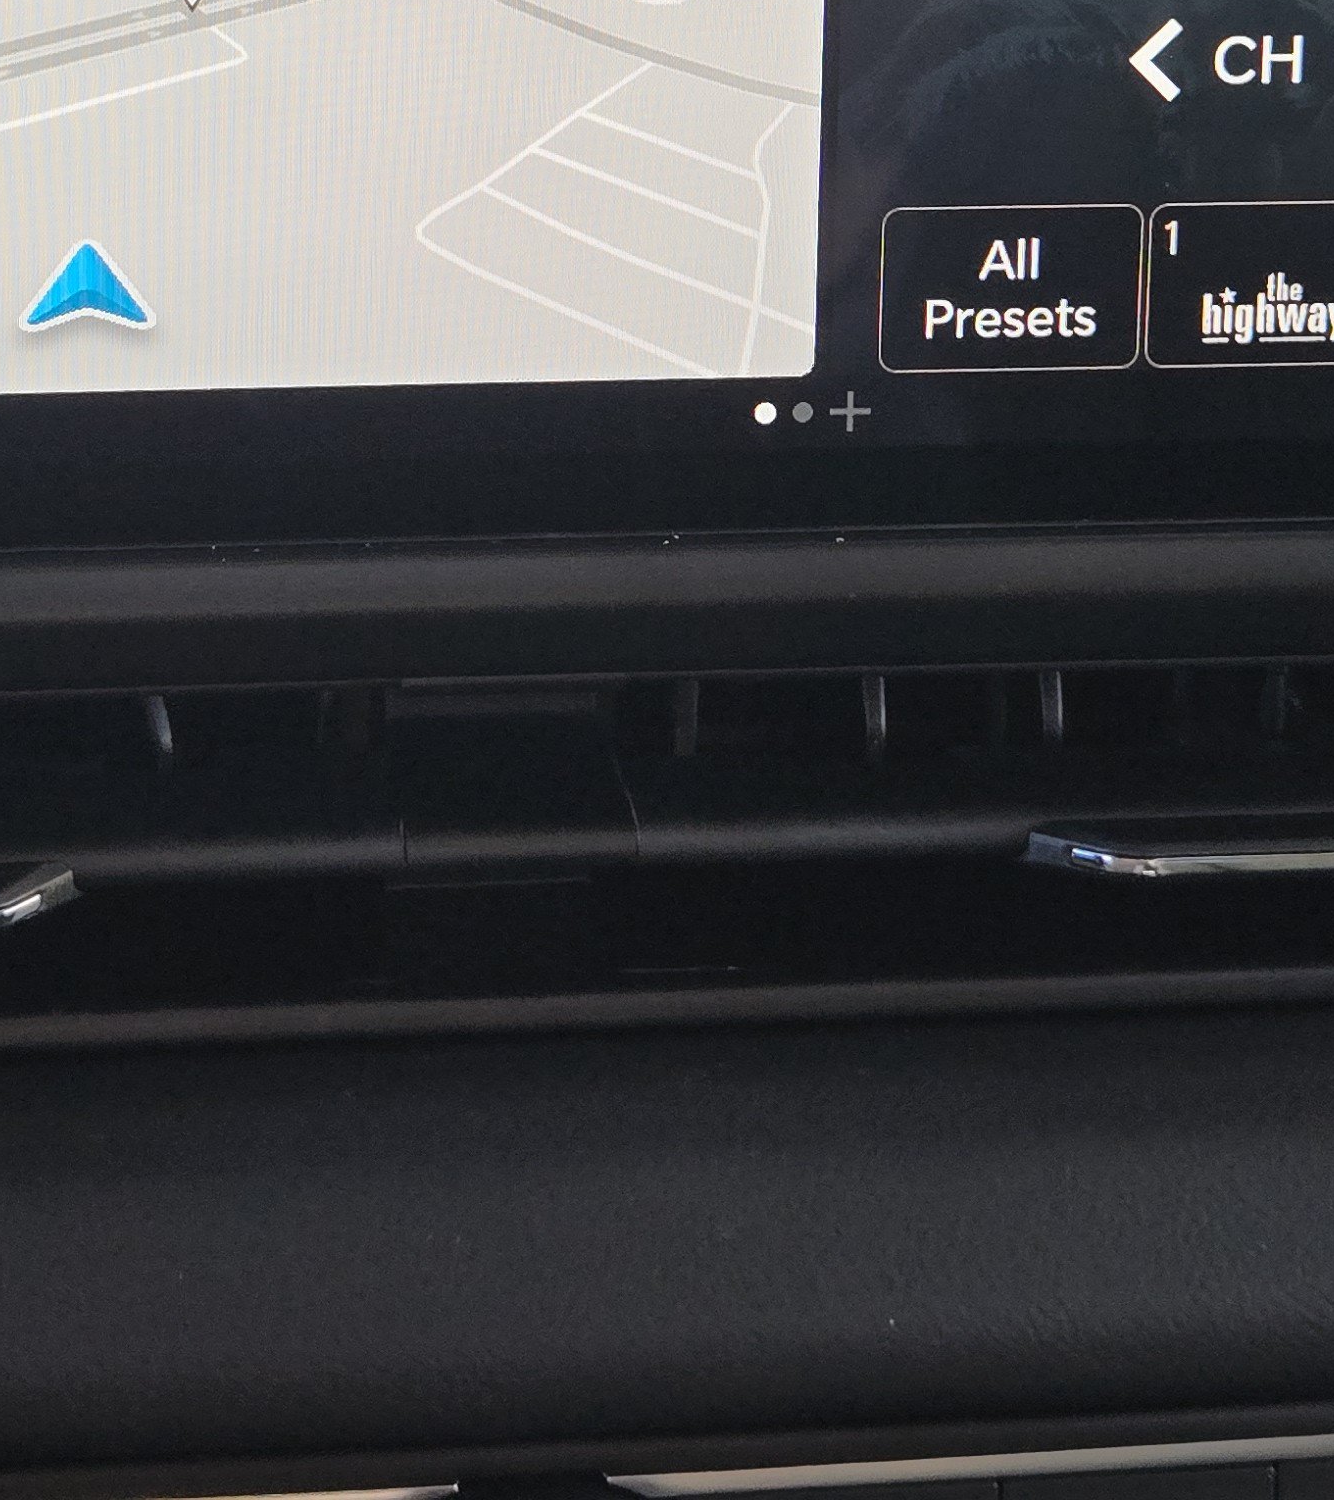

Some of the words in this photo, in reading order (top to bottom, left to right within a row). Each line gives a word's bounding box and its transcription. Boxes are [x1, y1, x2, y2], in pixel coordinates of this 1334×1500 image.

[1213, 34, 1305, 85] CH
[978, 237, 1041, 281] All
[1164, 220, 1180, 256] 1
[1266, 271, 1303, 302] the
[923, 297, 1098, 340] Presets
